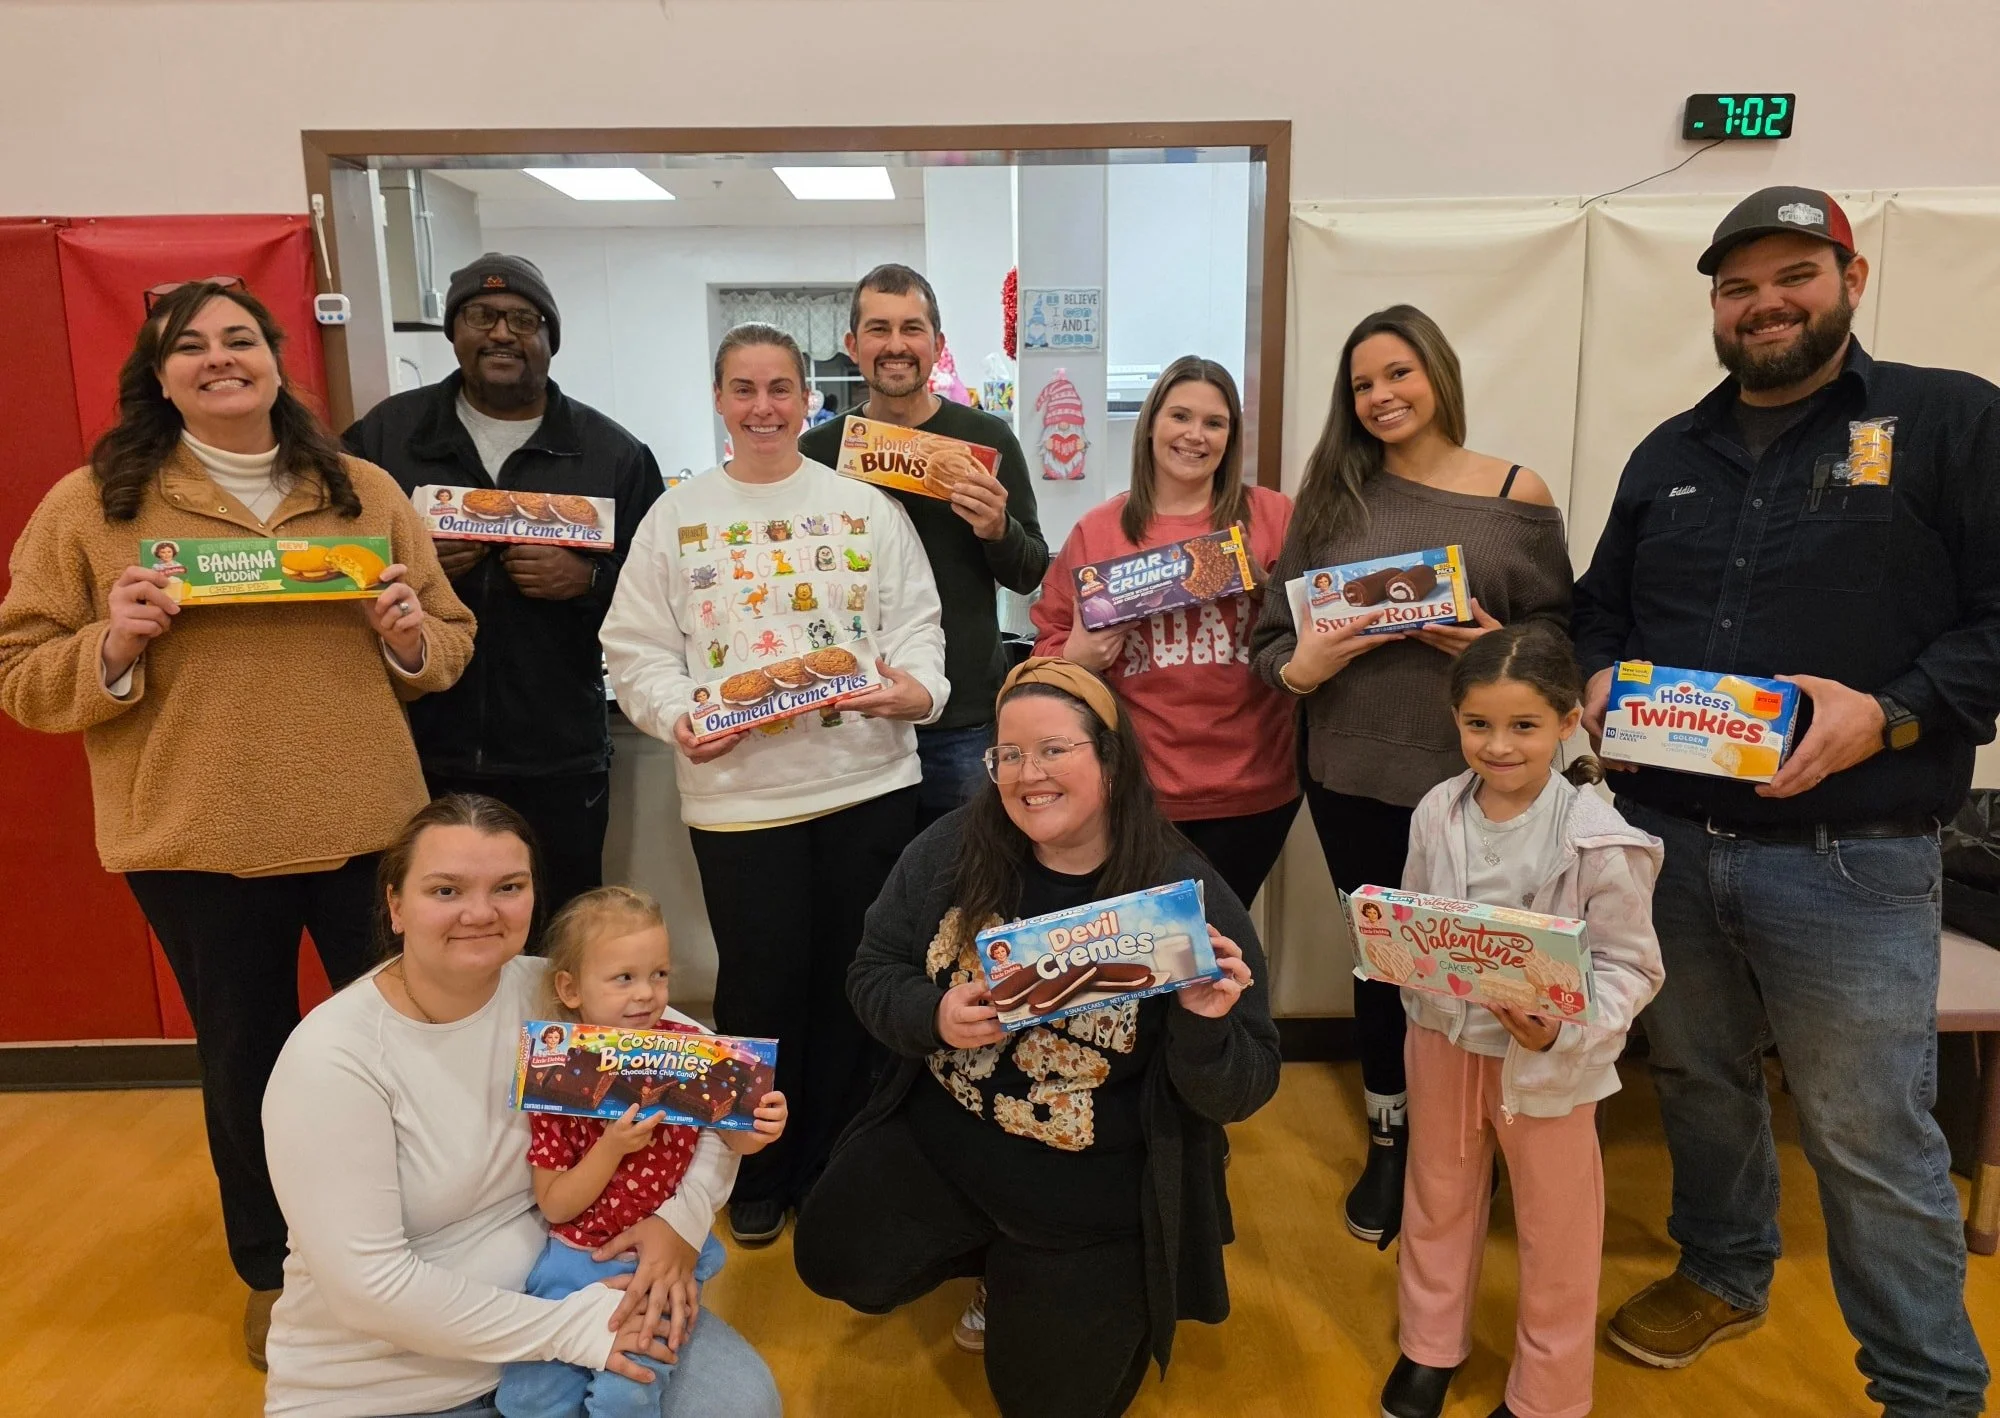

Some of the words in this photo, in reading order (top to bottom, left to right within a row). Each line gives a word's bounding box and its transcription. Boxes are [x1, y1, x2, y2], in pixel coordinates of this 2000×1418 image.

[1717, 97, 1788, 136] 7:02
[1064, 293, 1098, 305] BELIEVE
[1061, 319, 1082, 332] AND
[874, 435, 919, 460] Honey
[861, 452, 928, 479] BUNS
[1668, 485, 1697, 498] Eddie
[439, 515, 509, 536] Oatmeal
[512, 519, 562, 538] Creme
[566, 523, 603, 541] Pies
[277, 540, 308, 551] NEW!
[197, 550, 276, 573] BANANA
[1110, 552, 1163, 580] STAR
[1437, 567, 1455, 575] PACK
[209, 583, 245, 595] CREME
[248, 581, 270, 592] PIES
[1108, 560, 1188, 595] CRUNCH
[1384, 601, 1454, 624] ROLLS
[706, 697, 775, 732] Oatmeal
[777, 687, 829, 711] Creme
[830, 674, 868, 695] Pies
[1661, 690, 1732, 711] Hostess
[1607, 728, 1615, 737] 10
[1625, 702, 1764, 744] Twinkies
[1620, 731, 1648, 740] WRAPPED
[1673, 734, 1704, 744] GOLDEN
[1048, 909, 1121, 952] Devil
[1036, 932, 1155, 980] Cremes
[1400, 917, 1534, 974] Valentine
[1439, 960, 1473, 975] CAKES
[1110, 996, 1121, 1004] NET
[1120, 994, 1130, 1002] WT
[1561, 991, 1575, 1004] 10
[1068, 1005, 1088, 1016] SNACK
[1088, 1001, 1105, 1011] CAKES
[618, 1033, 700, 1055] Cosmic
[547, 1055, 566, 1063] Debbie
[596, 1046, 713, 1074] Brownies
[620, 1068, 658, 1077] Chocolate
[659, 1068, 675, 1078] Chip
[676, 1070, 698, 1080] Candy
